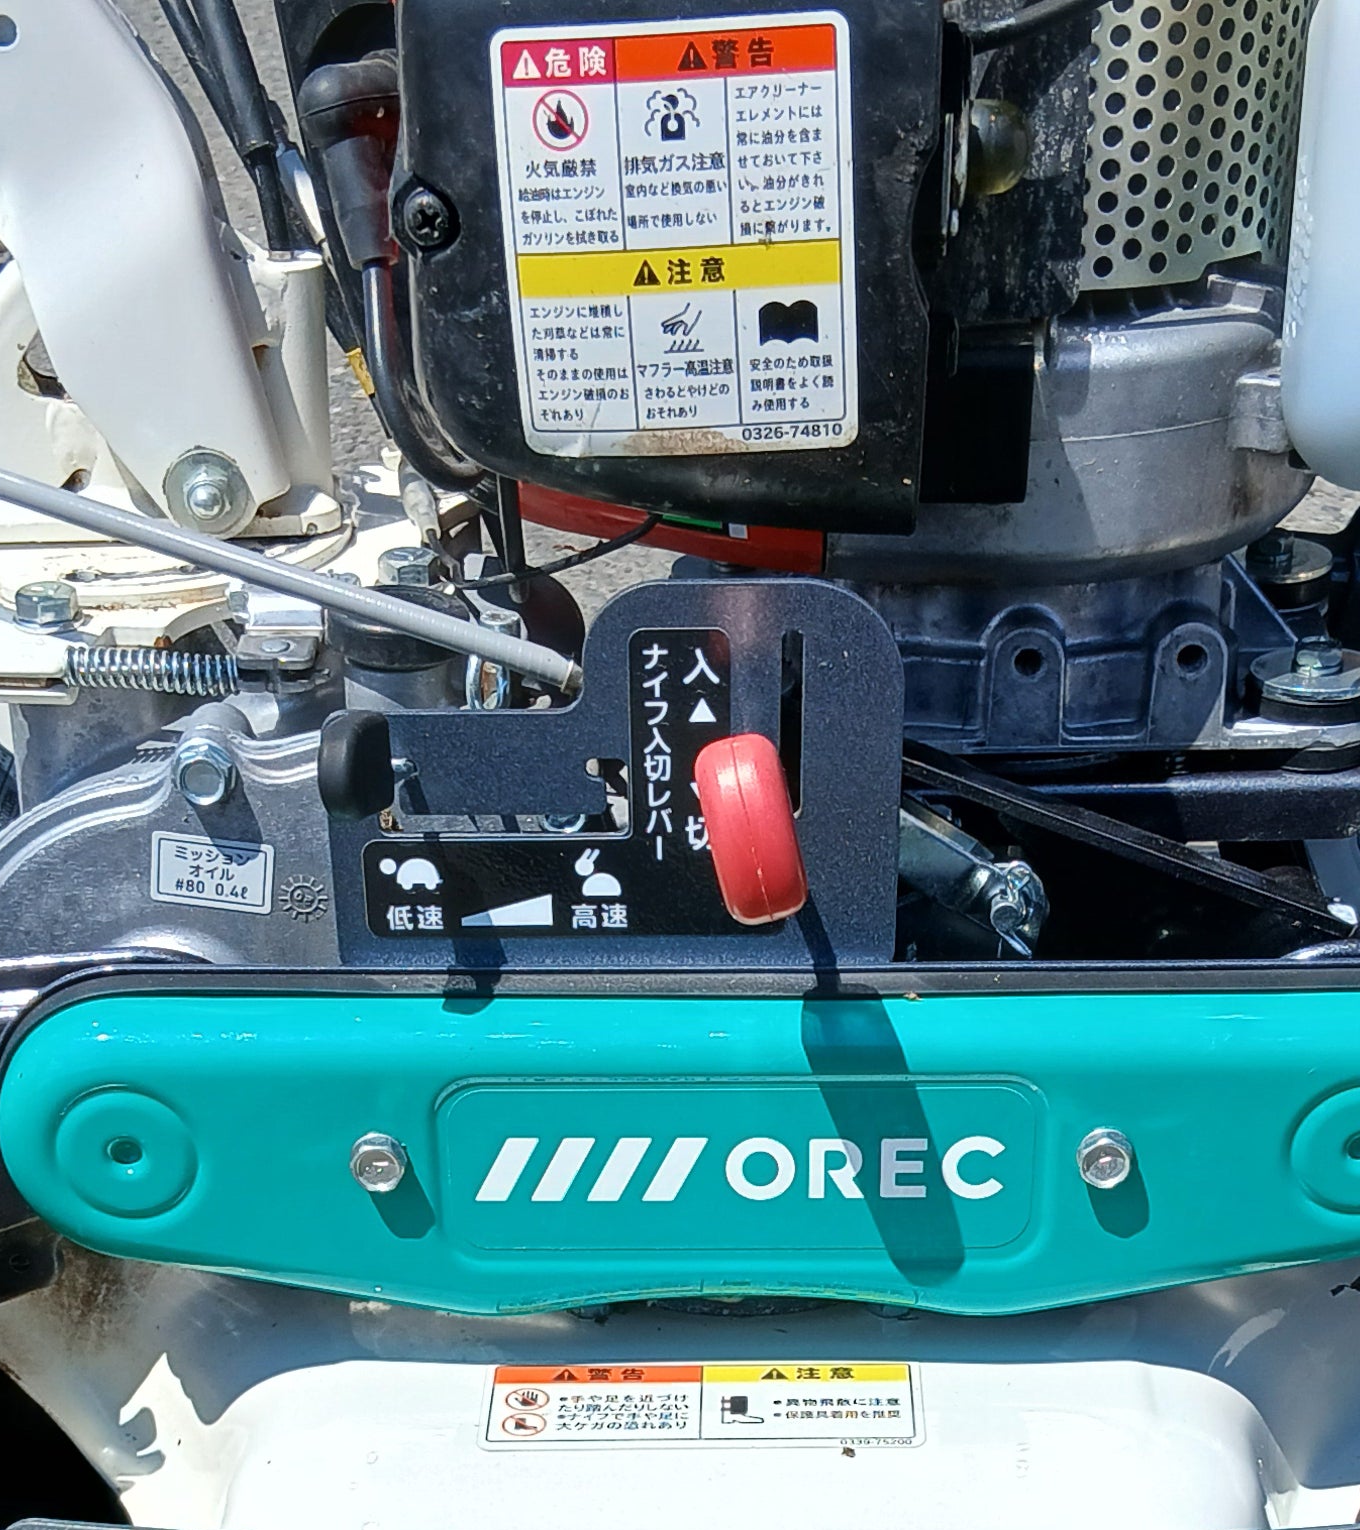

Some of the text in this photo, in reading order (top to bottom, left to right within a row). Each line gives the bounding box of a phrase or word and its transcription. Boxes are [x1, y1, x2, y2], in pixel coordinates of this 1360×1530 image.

[544, 45, 607, 78] 危険
[711, 36, 775, 70] 警告
[734, 81, 822, 99] エアクリーナー
[735, 104, 823, 122] エレメントには
[736, 127, 822, 146] 常に油分を含ま
[624, 151, 726, 176] 排気ガス注意
[737, 151, 823, 168] せておいて下さ
[525, 159, 597, 179] 火気厳禁
[624, 179, 728, 198] 室内など換気の悪い
[740, 195, 826, 213] るとエンジン破
[520, 207, 619, 225] を停止し、こぼれた
[627, 211, 718, 229] 場所で使用しない
[521, 230, 619, 246] ガソリンを拭き取る
[667, 256, 725, 285] 注意
[636, 357, 735, 379] マフラー高温注意
[749, 354, 834, 372] 安全のため取扱
[536, 367, 629, 381] そのままの使用は
[750, 374, 835, 392] 説明書をよく読
[538, 388, 630, 401] エンジン破損のお
[644, 383, 730, 400] さわるとやけどの
[645, 404, 698, 420] おそれあり
[751, 396, 810, 412] み使用する
[741, 423, 843, 441] 0326-74810
[682, 647, 720, 686] 入
[642, 642, 672, 862] ナイフ入切レバー
[174, 844, 251, 867] ミッション
[188, 864, 235, 882] オイル
[175, 879, 205, 894] #80
[386, 904, 444, 931] 低速
[571, 903, 628, 930] 高速
[725, 1135, 1007, 1200] OREC
[586, 1367, 645, 1381] 警告
[796, 1366, 855, 1380] 注意
